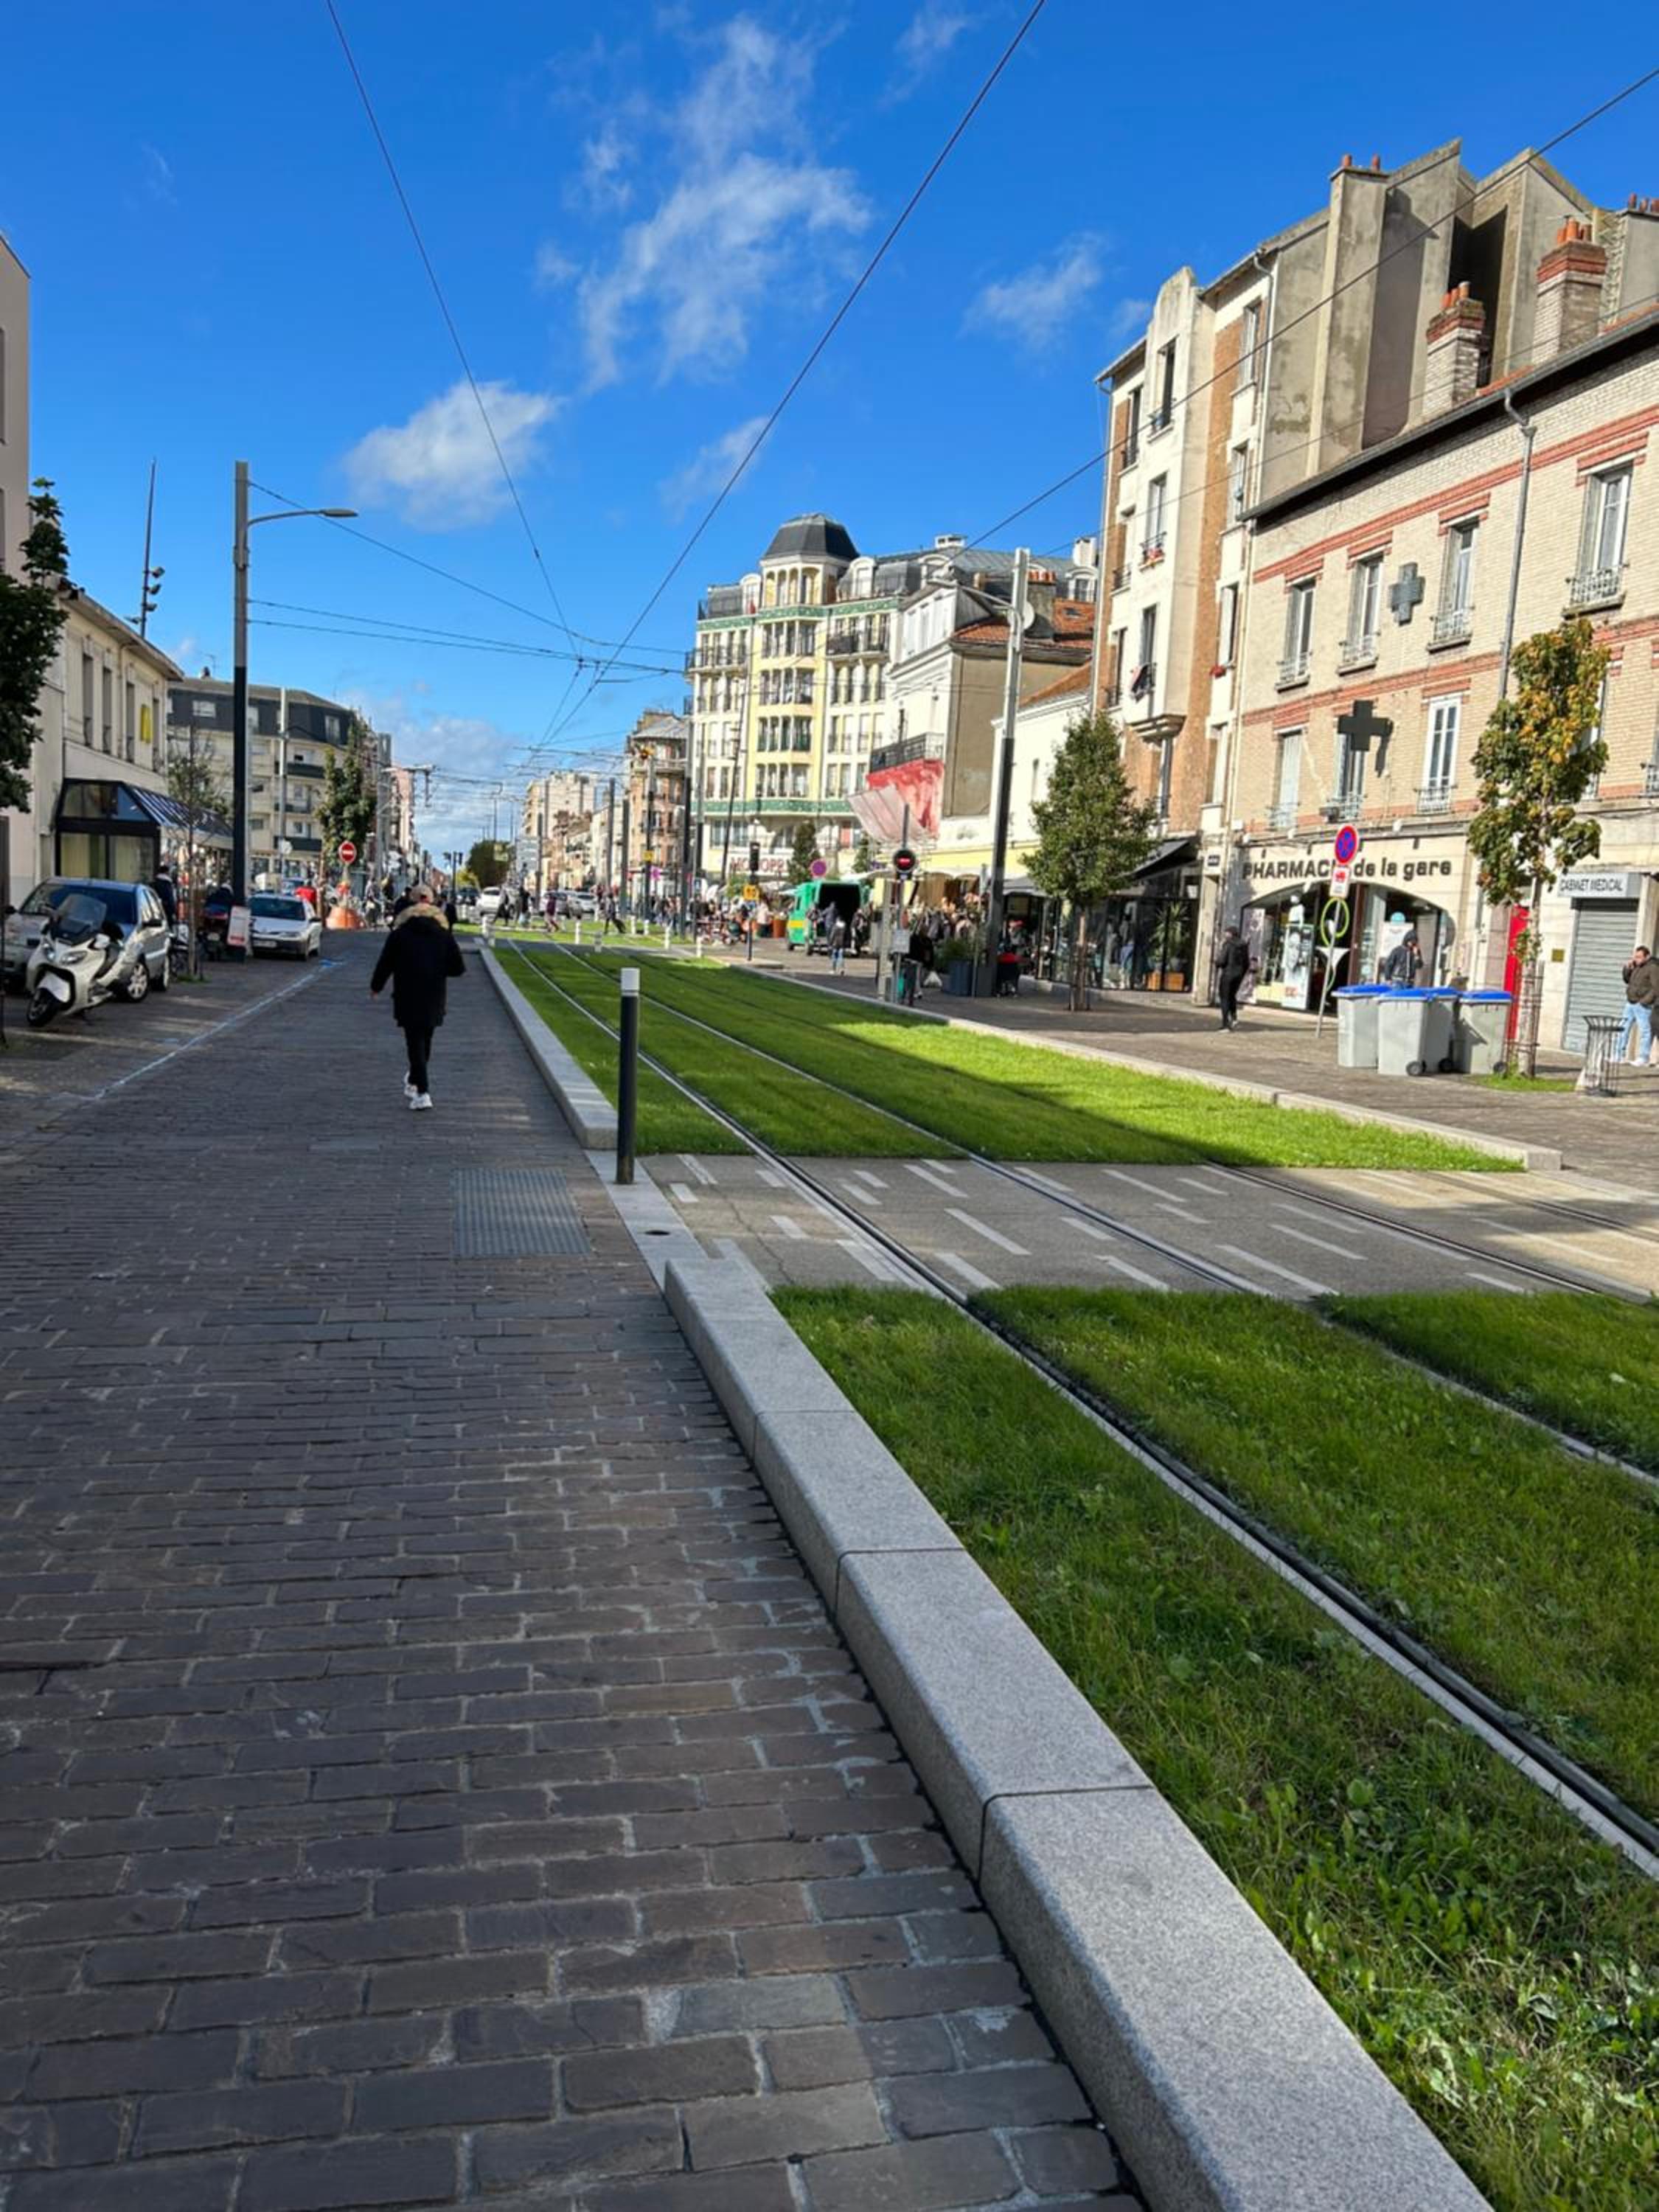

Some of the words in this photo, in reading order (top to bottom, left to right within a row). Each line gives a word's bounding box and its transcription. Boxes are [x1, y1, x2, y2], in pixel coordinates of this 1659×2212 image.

[1242, 859, 1350, 879] PHARMACI
[1354, 858, 1375, 877] de
[1381, 858, 1397, 876] la
[1404, 860, 1451, 880] gare
